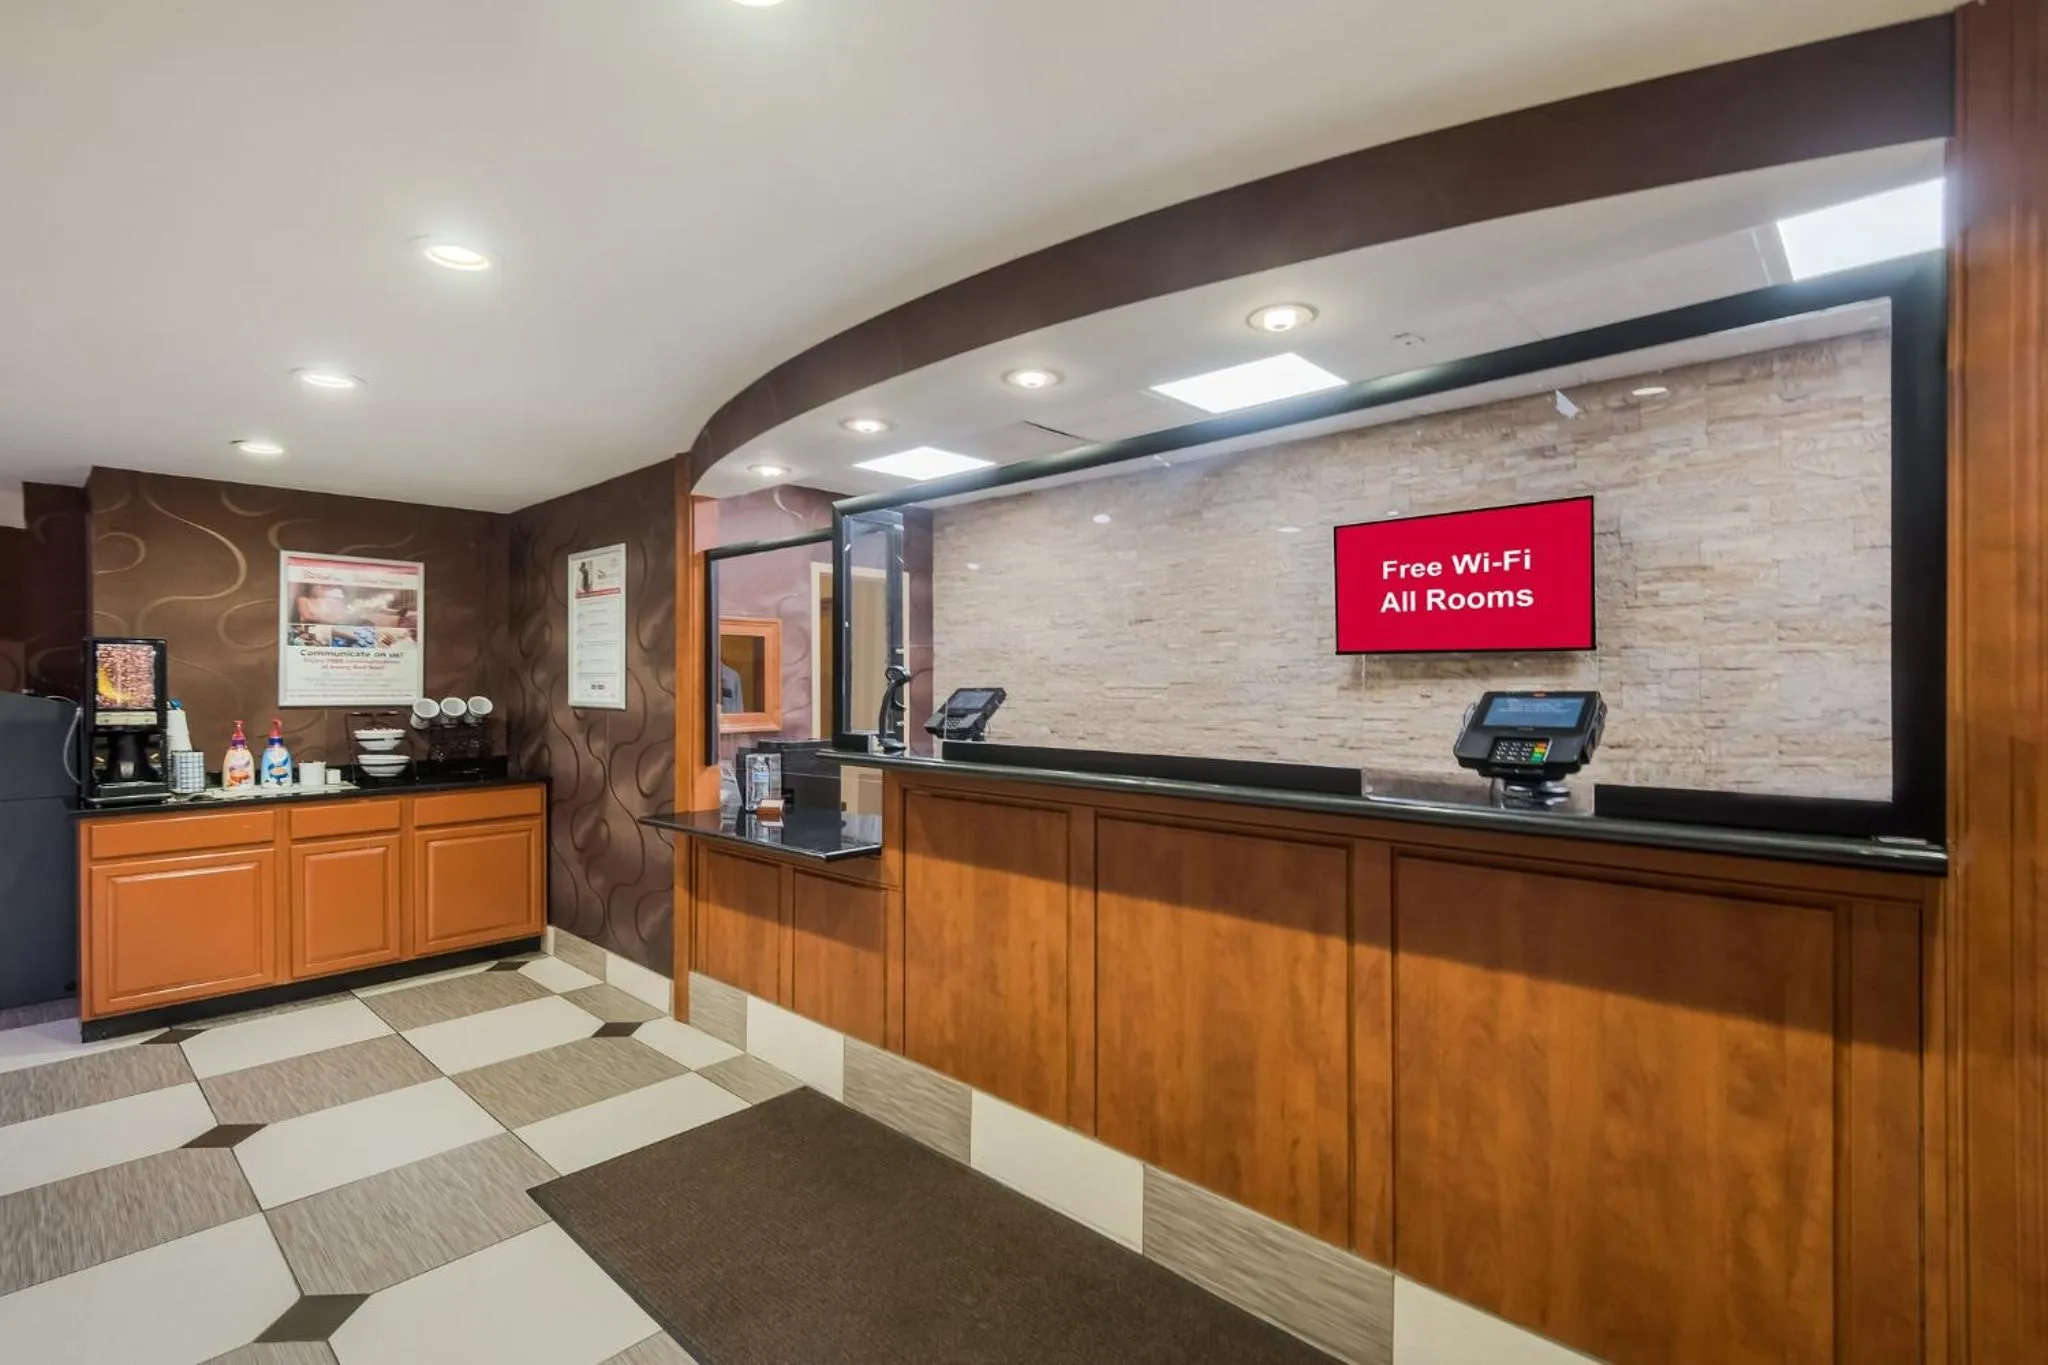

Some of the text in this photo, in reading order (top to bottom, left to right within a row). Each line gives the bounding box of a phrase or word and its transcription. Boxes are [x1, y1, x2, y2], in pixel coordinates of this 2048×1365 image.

[1382, 548, 1532, 580] Free Wi-Fi
[1380, 588, 1534, 613] All Rooms
[299, 649, 371, 658] Communicate
